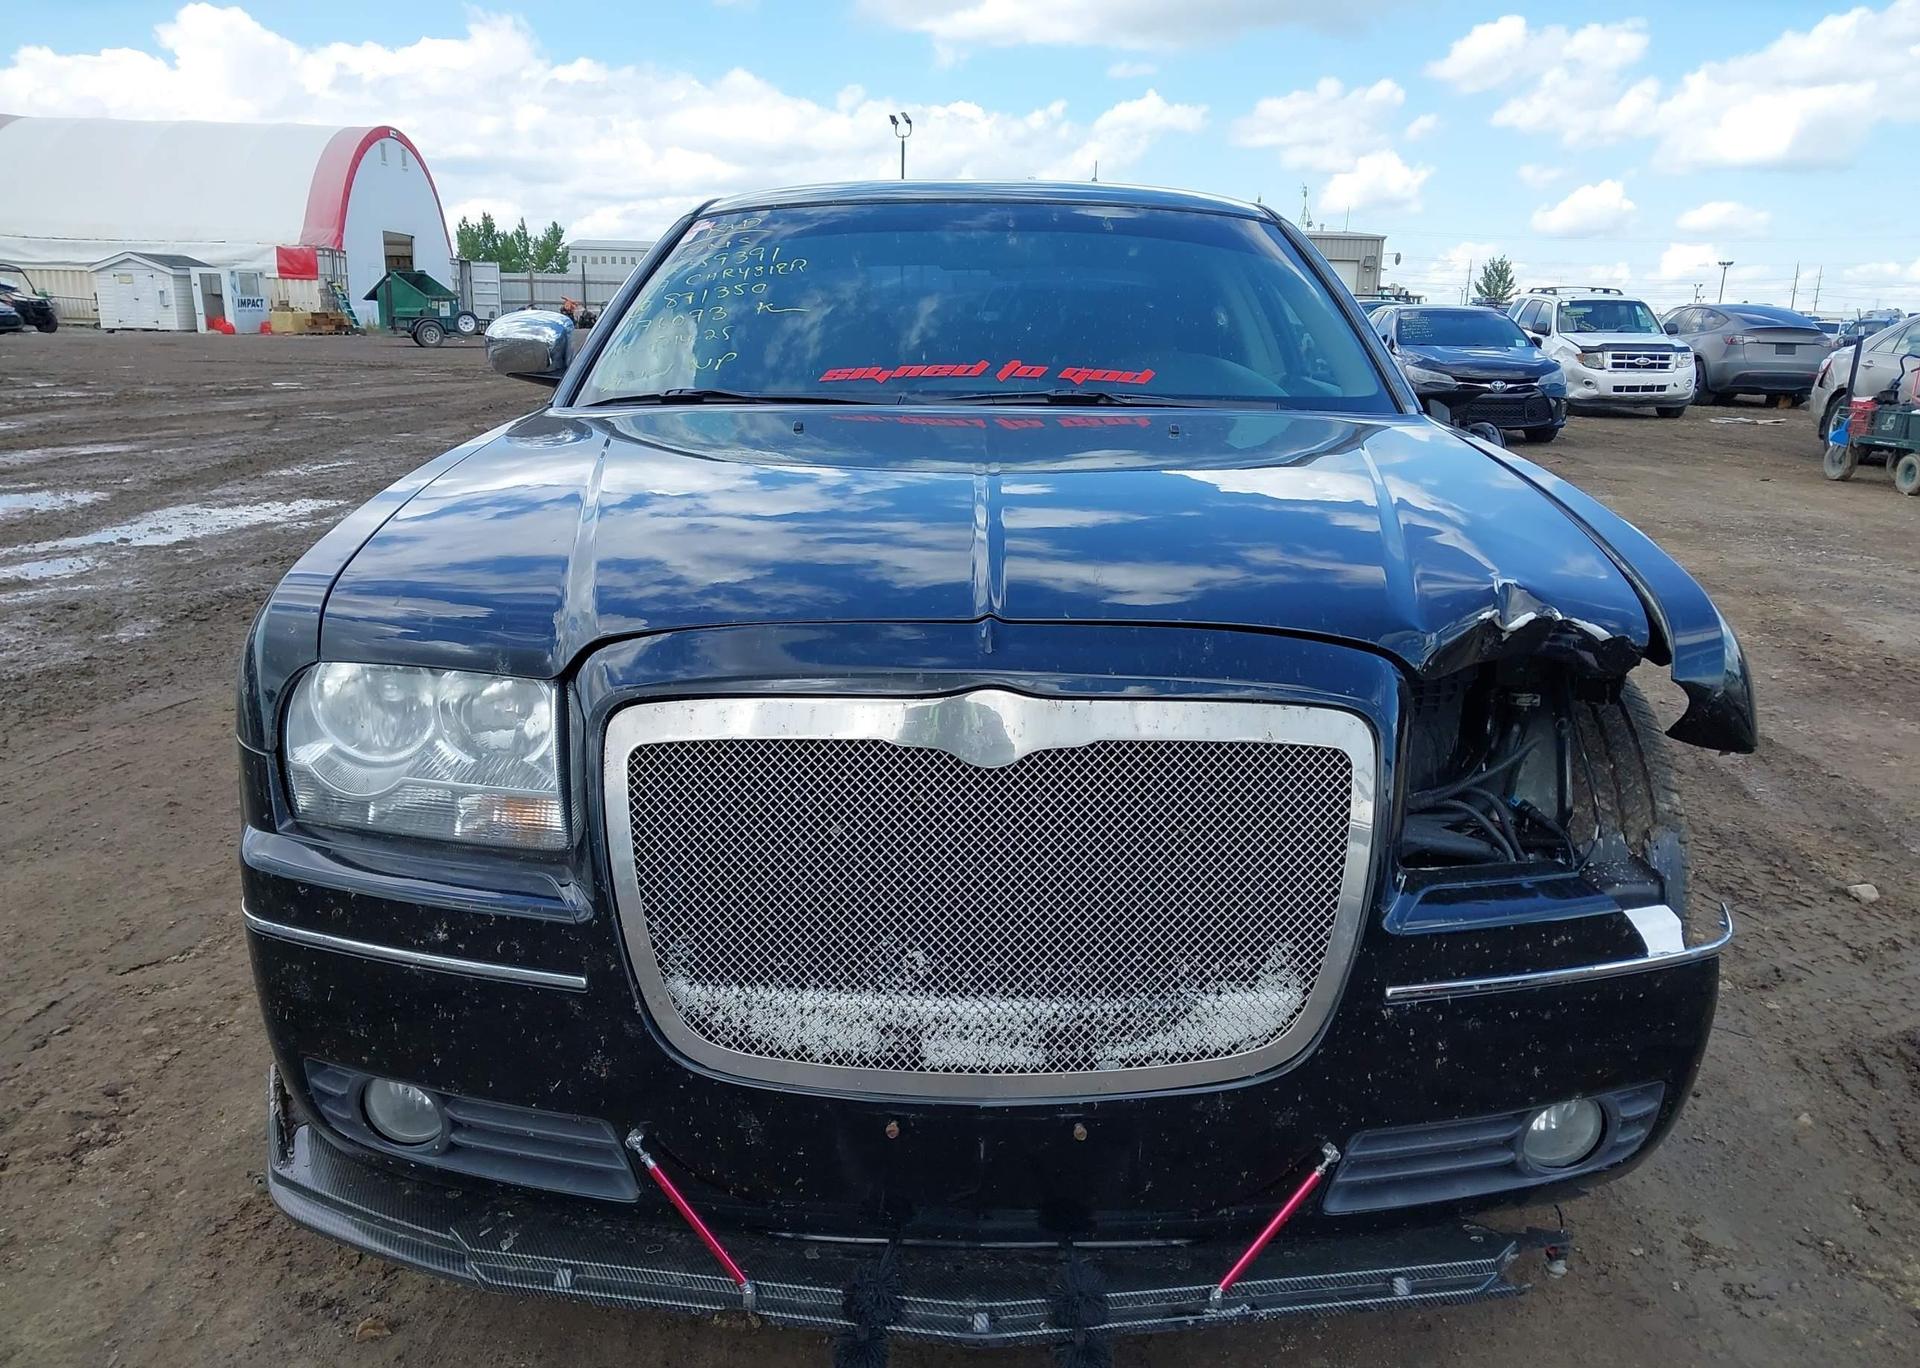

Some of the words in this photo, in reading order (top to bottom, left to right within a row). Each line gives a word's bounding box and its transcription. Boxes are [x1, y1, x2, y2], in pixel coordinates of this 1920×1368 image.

[237, 298, 264, 308] IMPACT
[995, 359, 1049, 382] to
[1056, 367, 1156, 385] god
